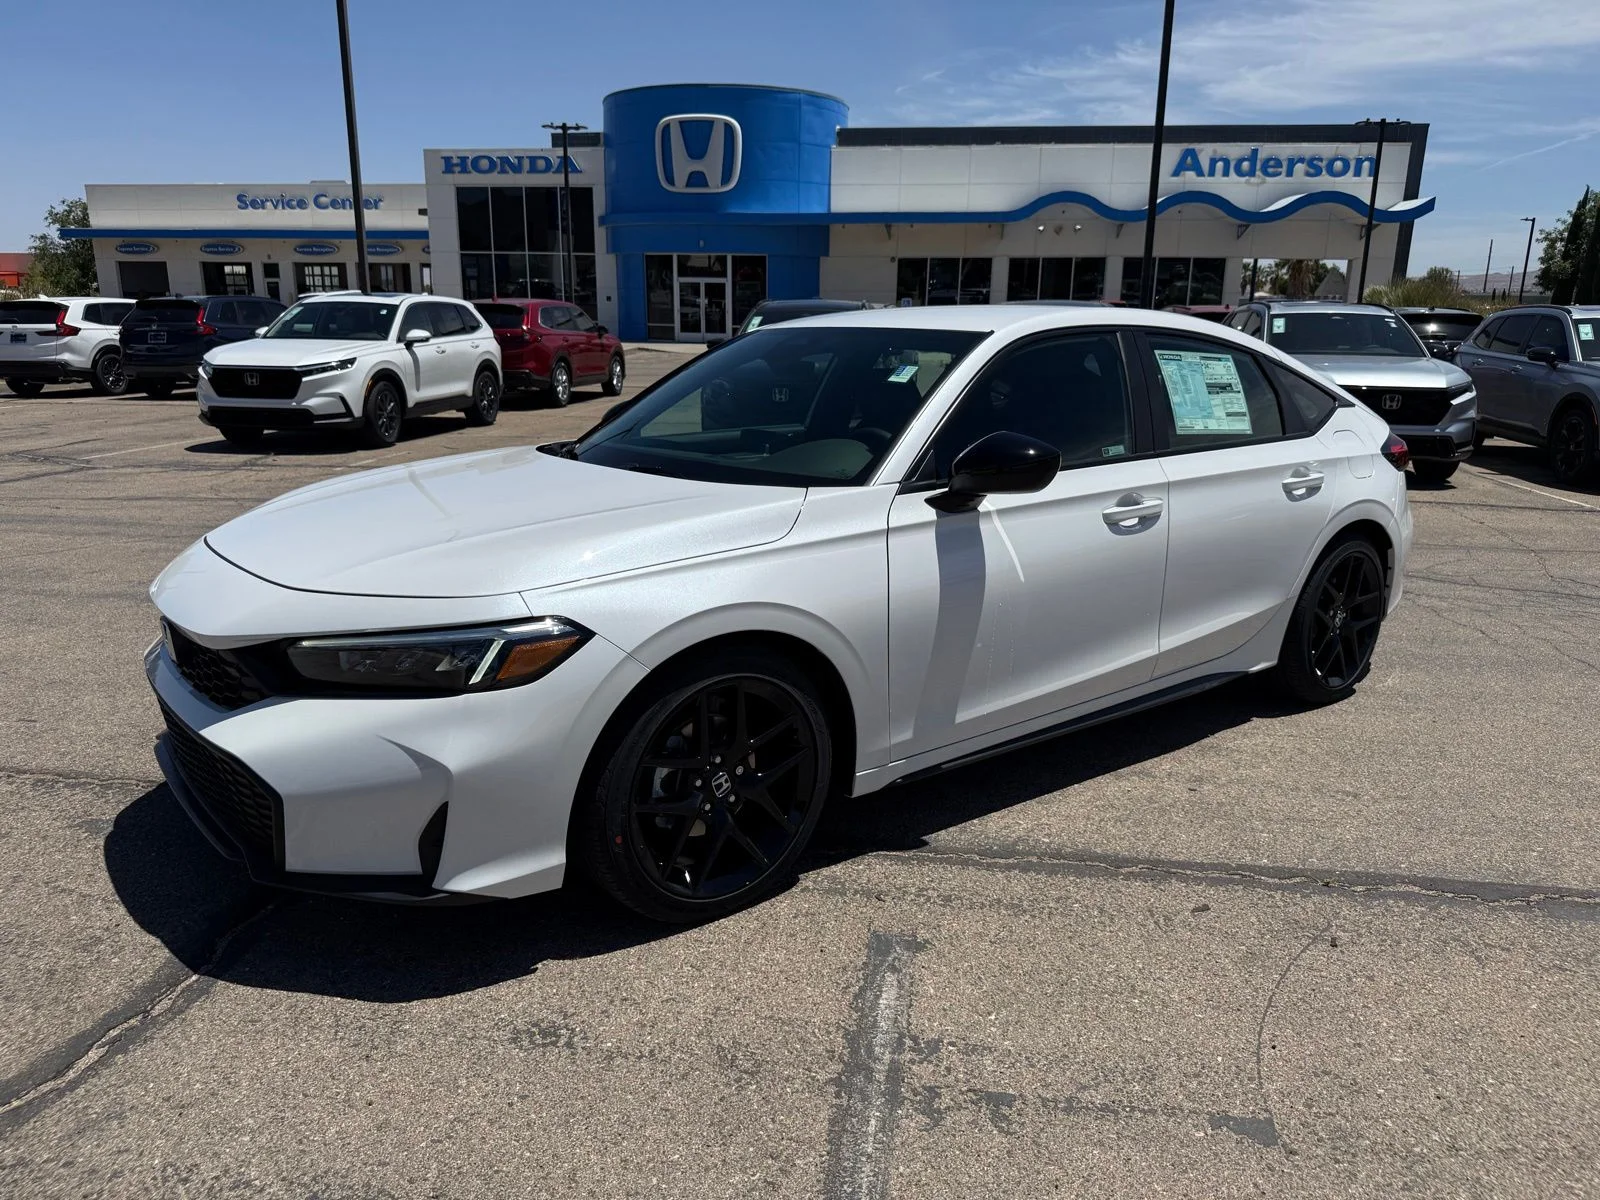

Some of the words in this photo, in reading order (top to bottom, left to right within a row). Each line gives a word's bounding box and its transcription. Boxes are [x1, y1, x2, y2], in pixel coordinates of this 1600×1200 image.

[440, 155, 583, 174] HONDA
[1171, 147, 1377, 178] Anderson
[236, 193, 309, 210] Service
[313, 193, 384, 210] Cener
